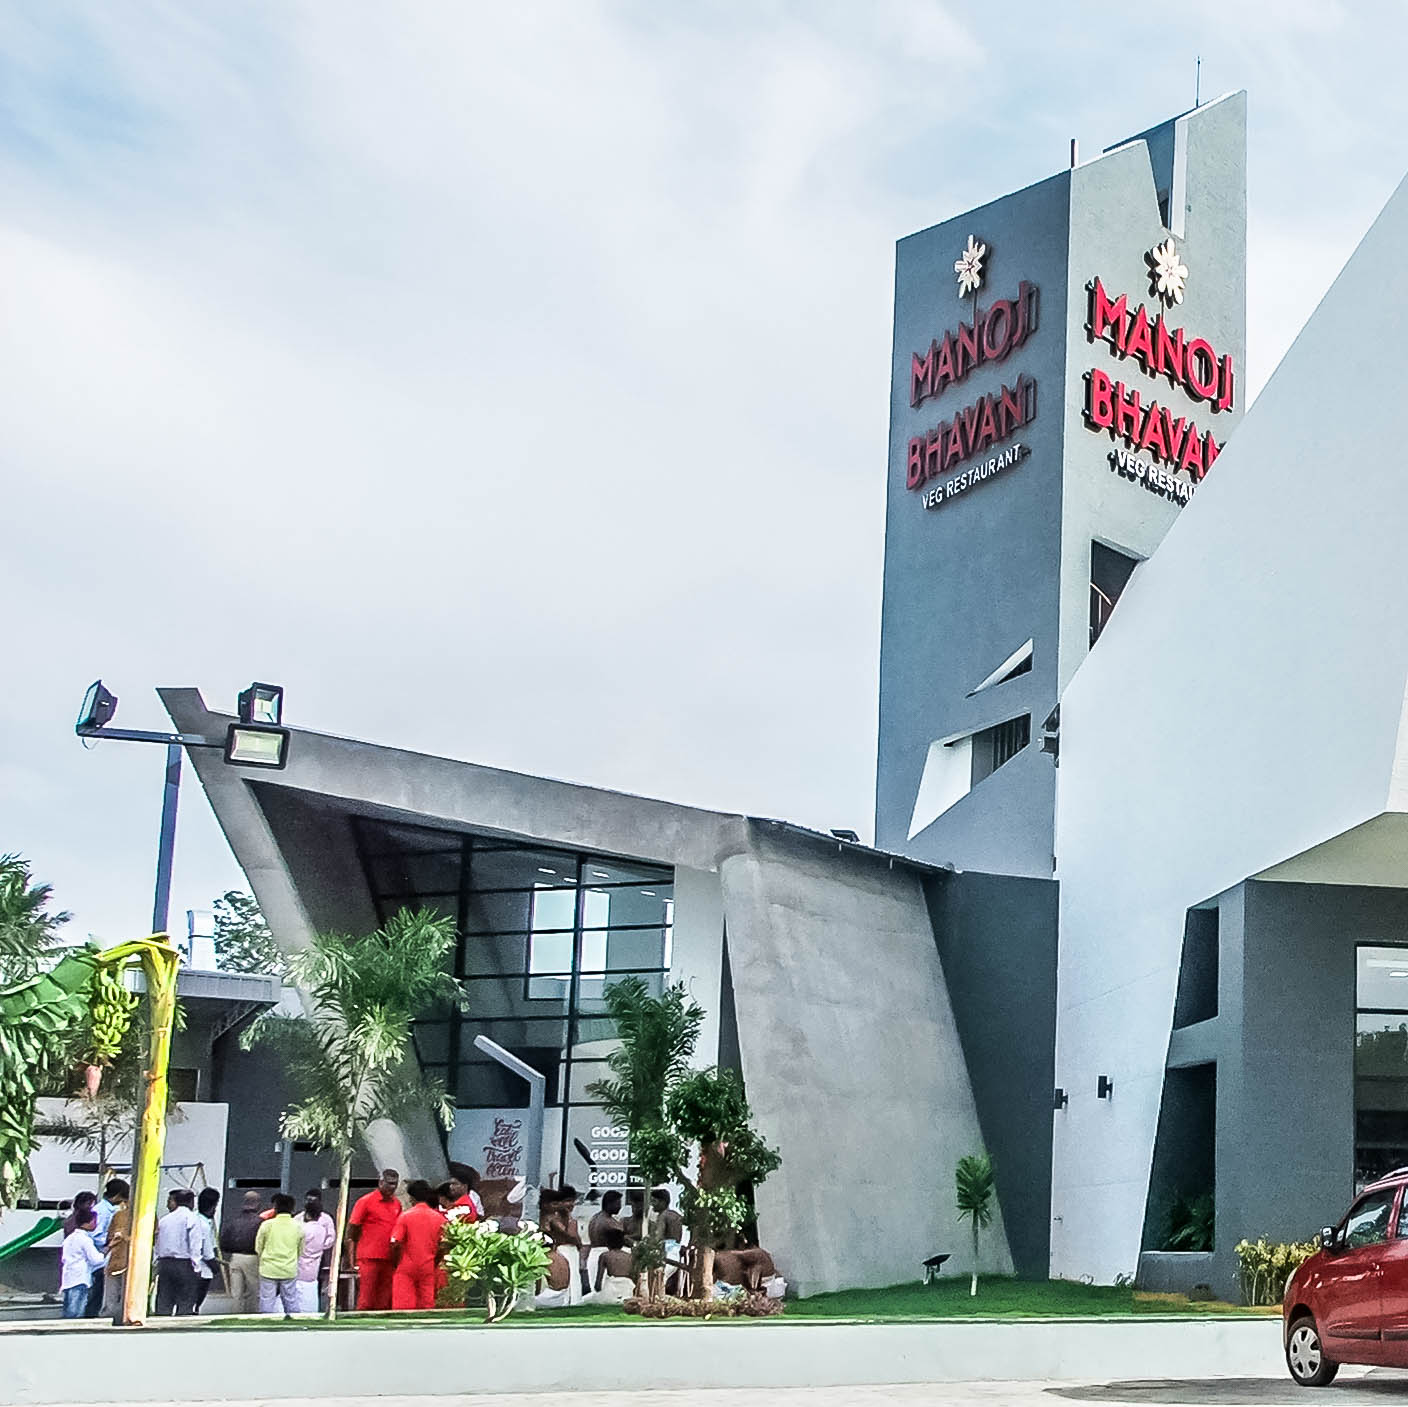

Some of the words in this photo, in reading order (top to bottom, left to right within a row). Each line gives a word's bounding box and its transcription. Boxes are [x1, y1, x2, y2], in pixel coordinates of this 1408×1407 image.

[910, 280, 1030, 407] MANOJ
[1093, 276, 1232, 409] MANOJ
[922, 486, 943, 510] VEG
[946, 443, 1021, 498] RESTAURANT
[1117, 448, 1147, 478] VEG
[588, 1172, 627, 1184] GOOD
[590, 1149, 629, 1161] GOOD
